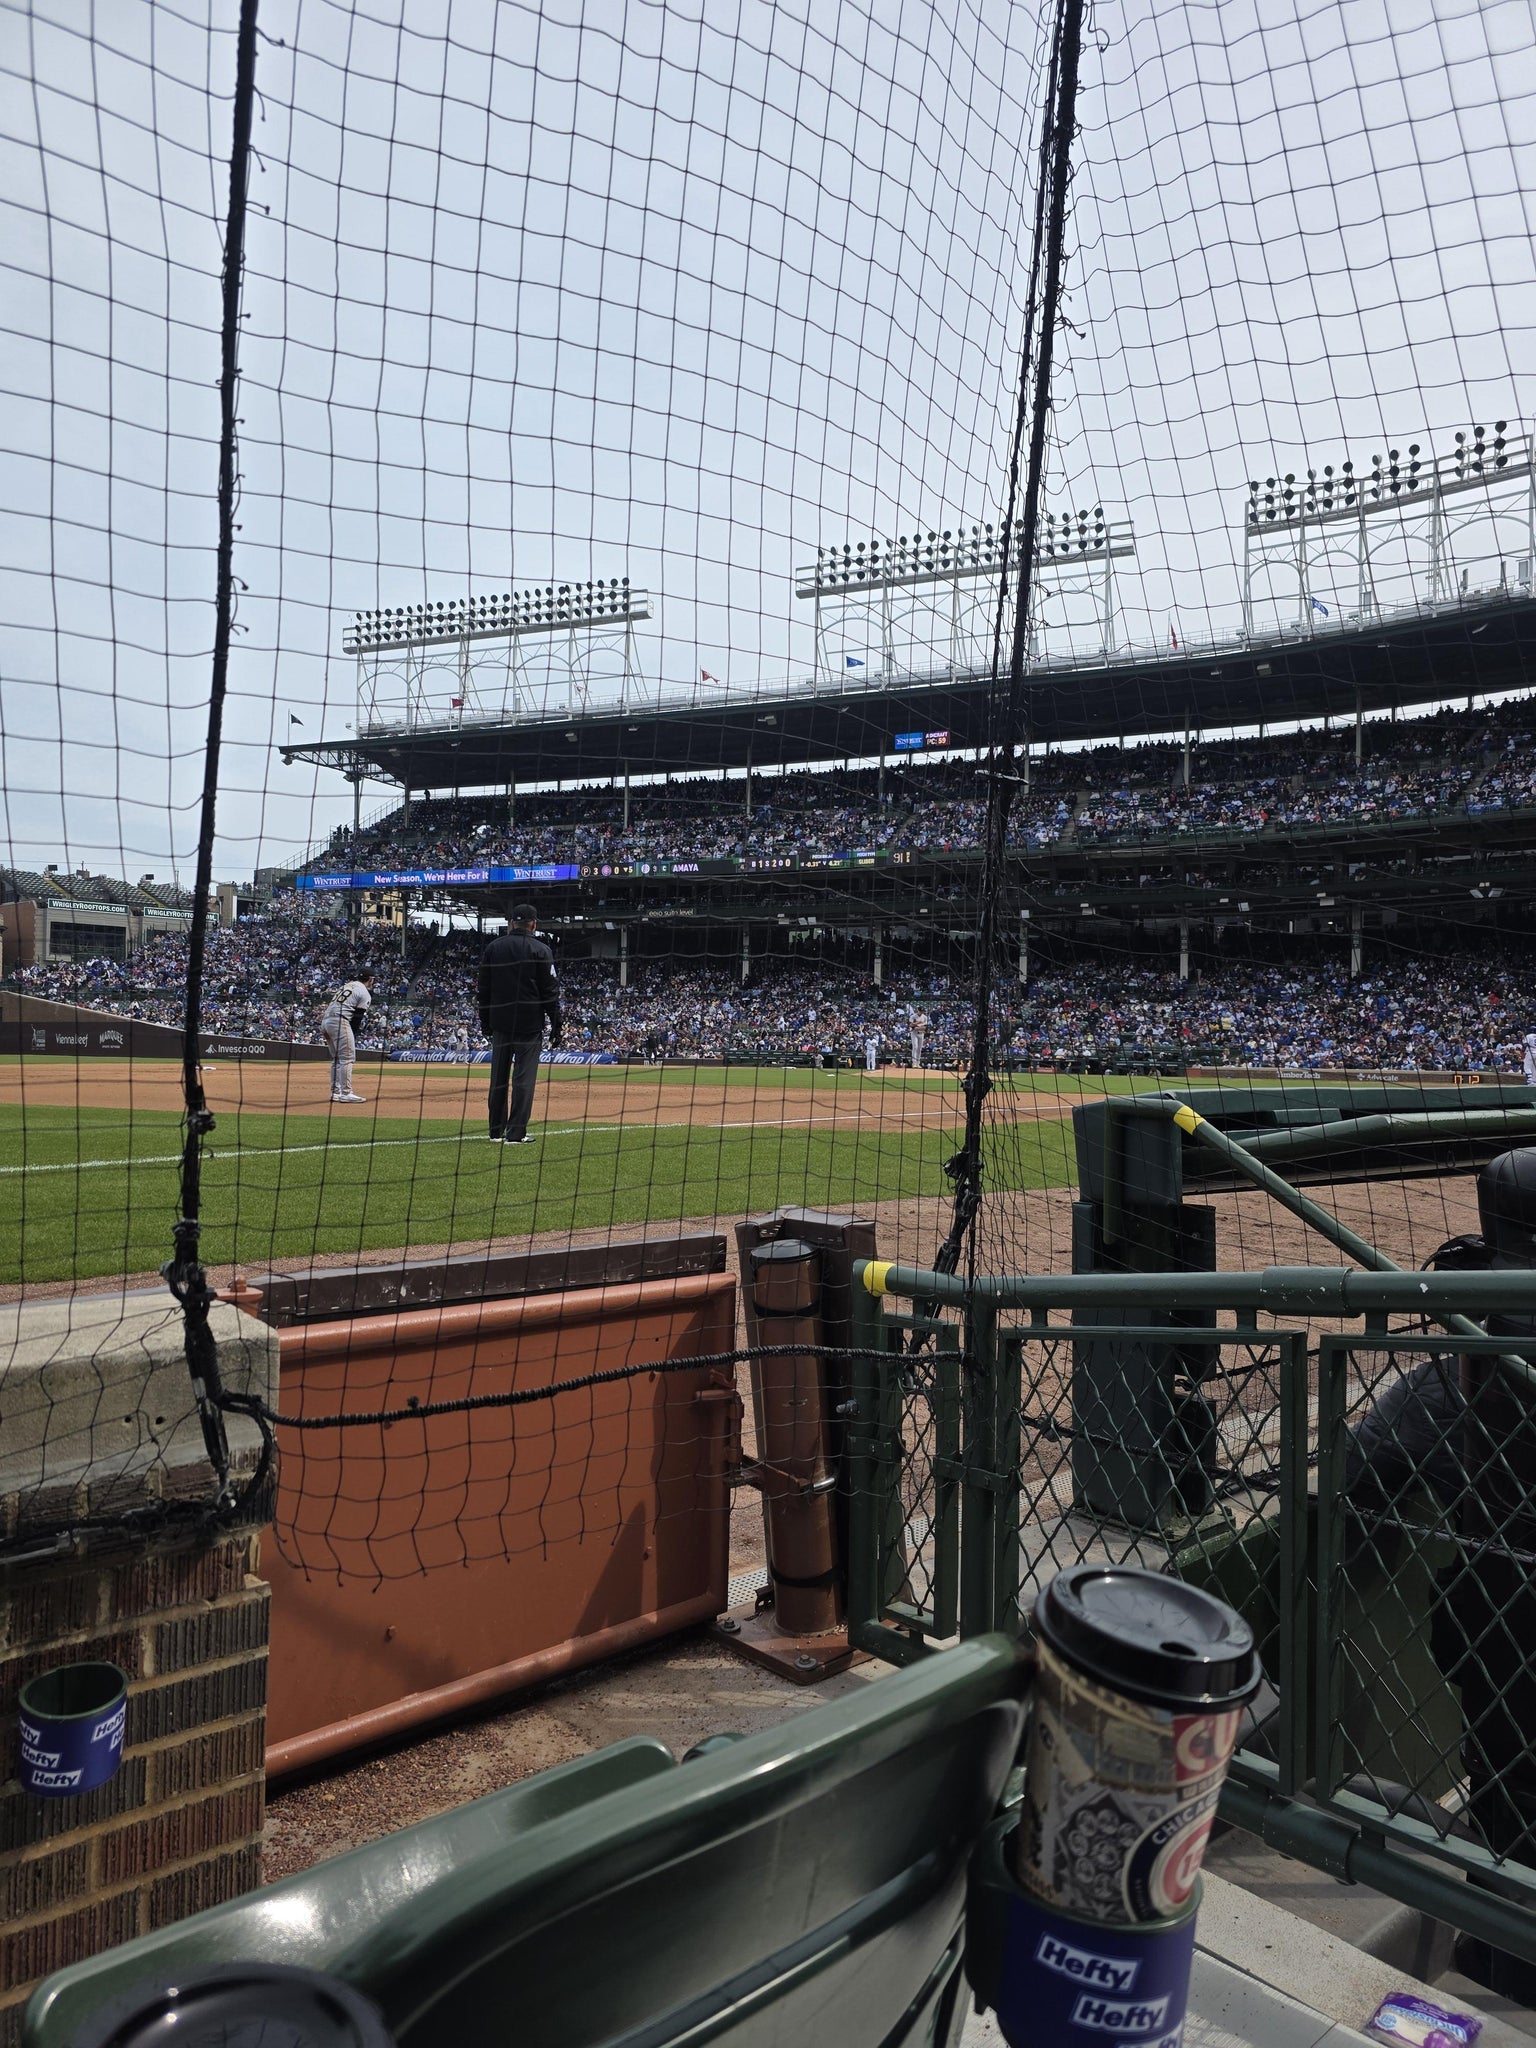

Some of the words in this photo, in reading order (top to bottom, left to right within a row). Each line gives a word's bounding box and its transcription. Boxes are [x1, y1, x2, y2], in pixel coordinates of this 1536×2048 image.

[513, 868, 558, 878] WINTRUST
[672, 863, 699, 872] AMAYA
[313, 877, 352, 886] WINTRUST
[374, 875, 391, 883] New
[393, 874, 422, 883] Season,
[424, 873, 445, 881] We're
[447, 872, 466, 880] Here
[467, 871, 481, 880] For
[482, 871, 489, 879] It
[99, 1030, 124, 1045] MARQUEE
[218, 1044, 248, 1053] Invesco
[248, 1045, 265, 1054] QQQ
[399, 1051, 444, 1062] Reynolds
[554, 1053, 584, 1064] Wrap
[22, 1744, 57, 1766] Hefty
[34, 1772, 78, 1786] Hefty
[1042, 1941, 1132, 1990] Hefty
[1079, 2000, 1163, 2030] Hefty
